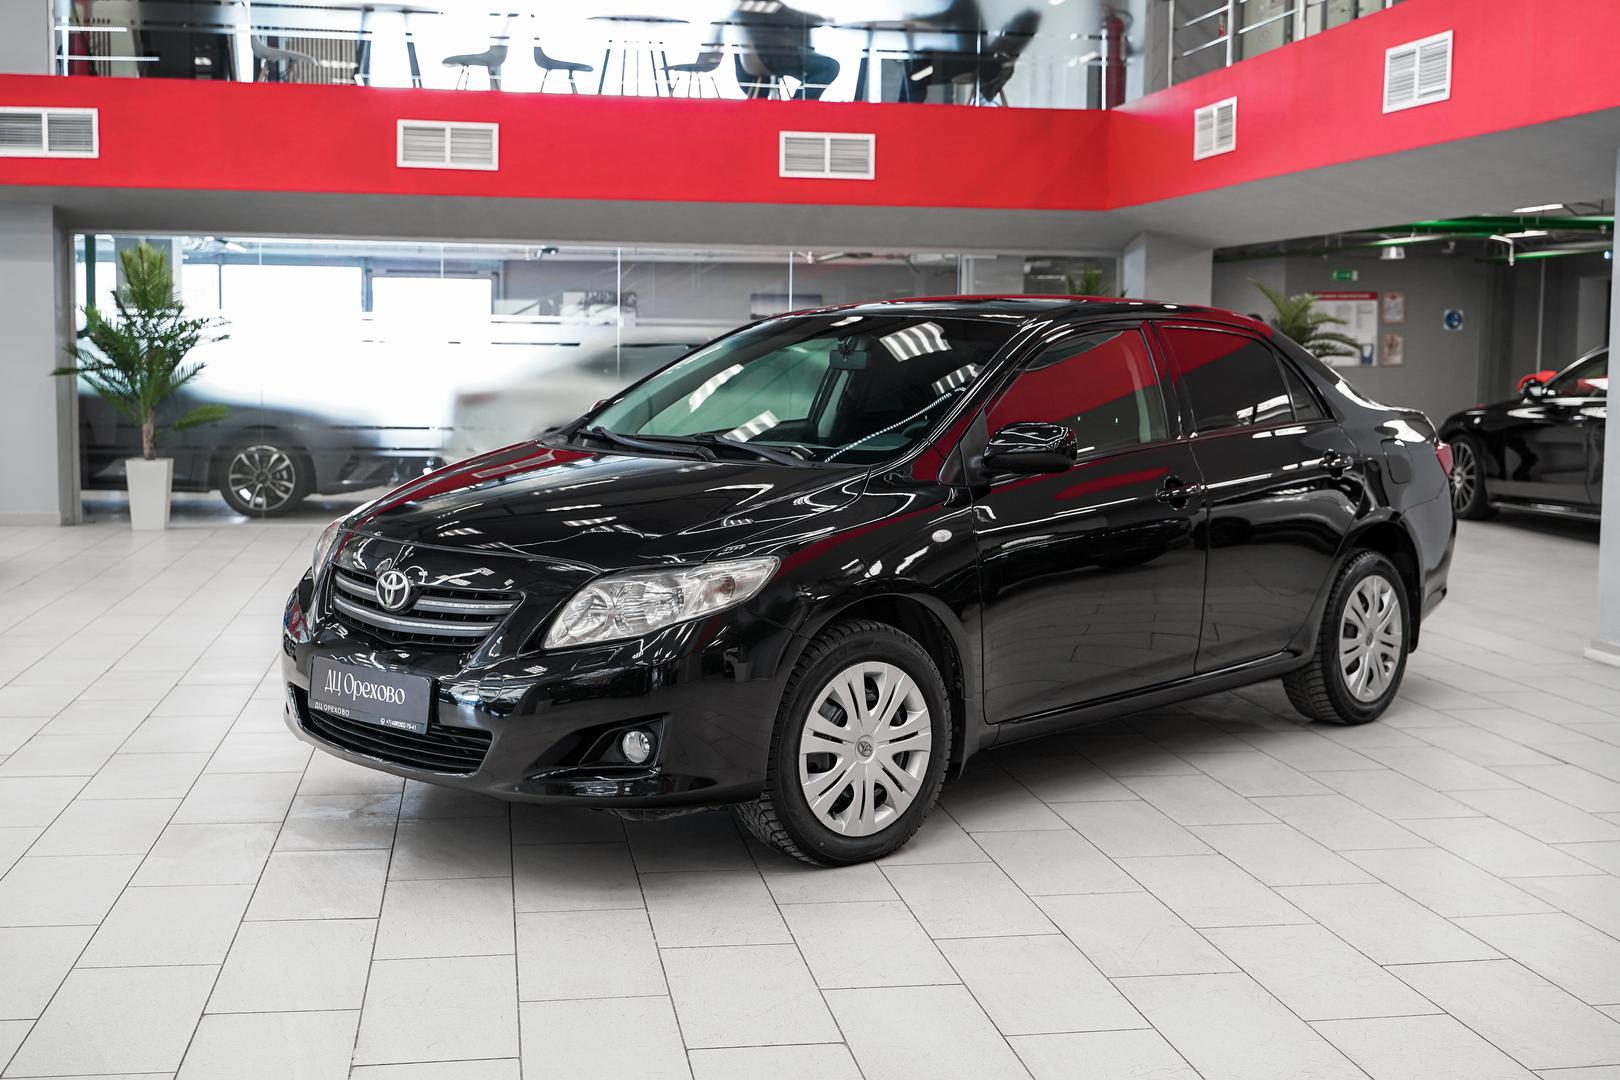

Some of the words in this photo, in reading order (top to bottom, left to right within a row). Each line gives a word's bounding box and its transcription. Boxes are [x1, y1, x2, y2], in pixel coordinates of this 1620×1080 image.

[325, 669, 342, 696] ДЦ
[343, 673, 405, 705] Орехово
[314, 701, 323, 710] ДЦ
[323, 703, 350, 717] ОРЕХОВО
